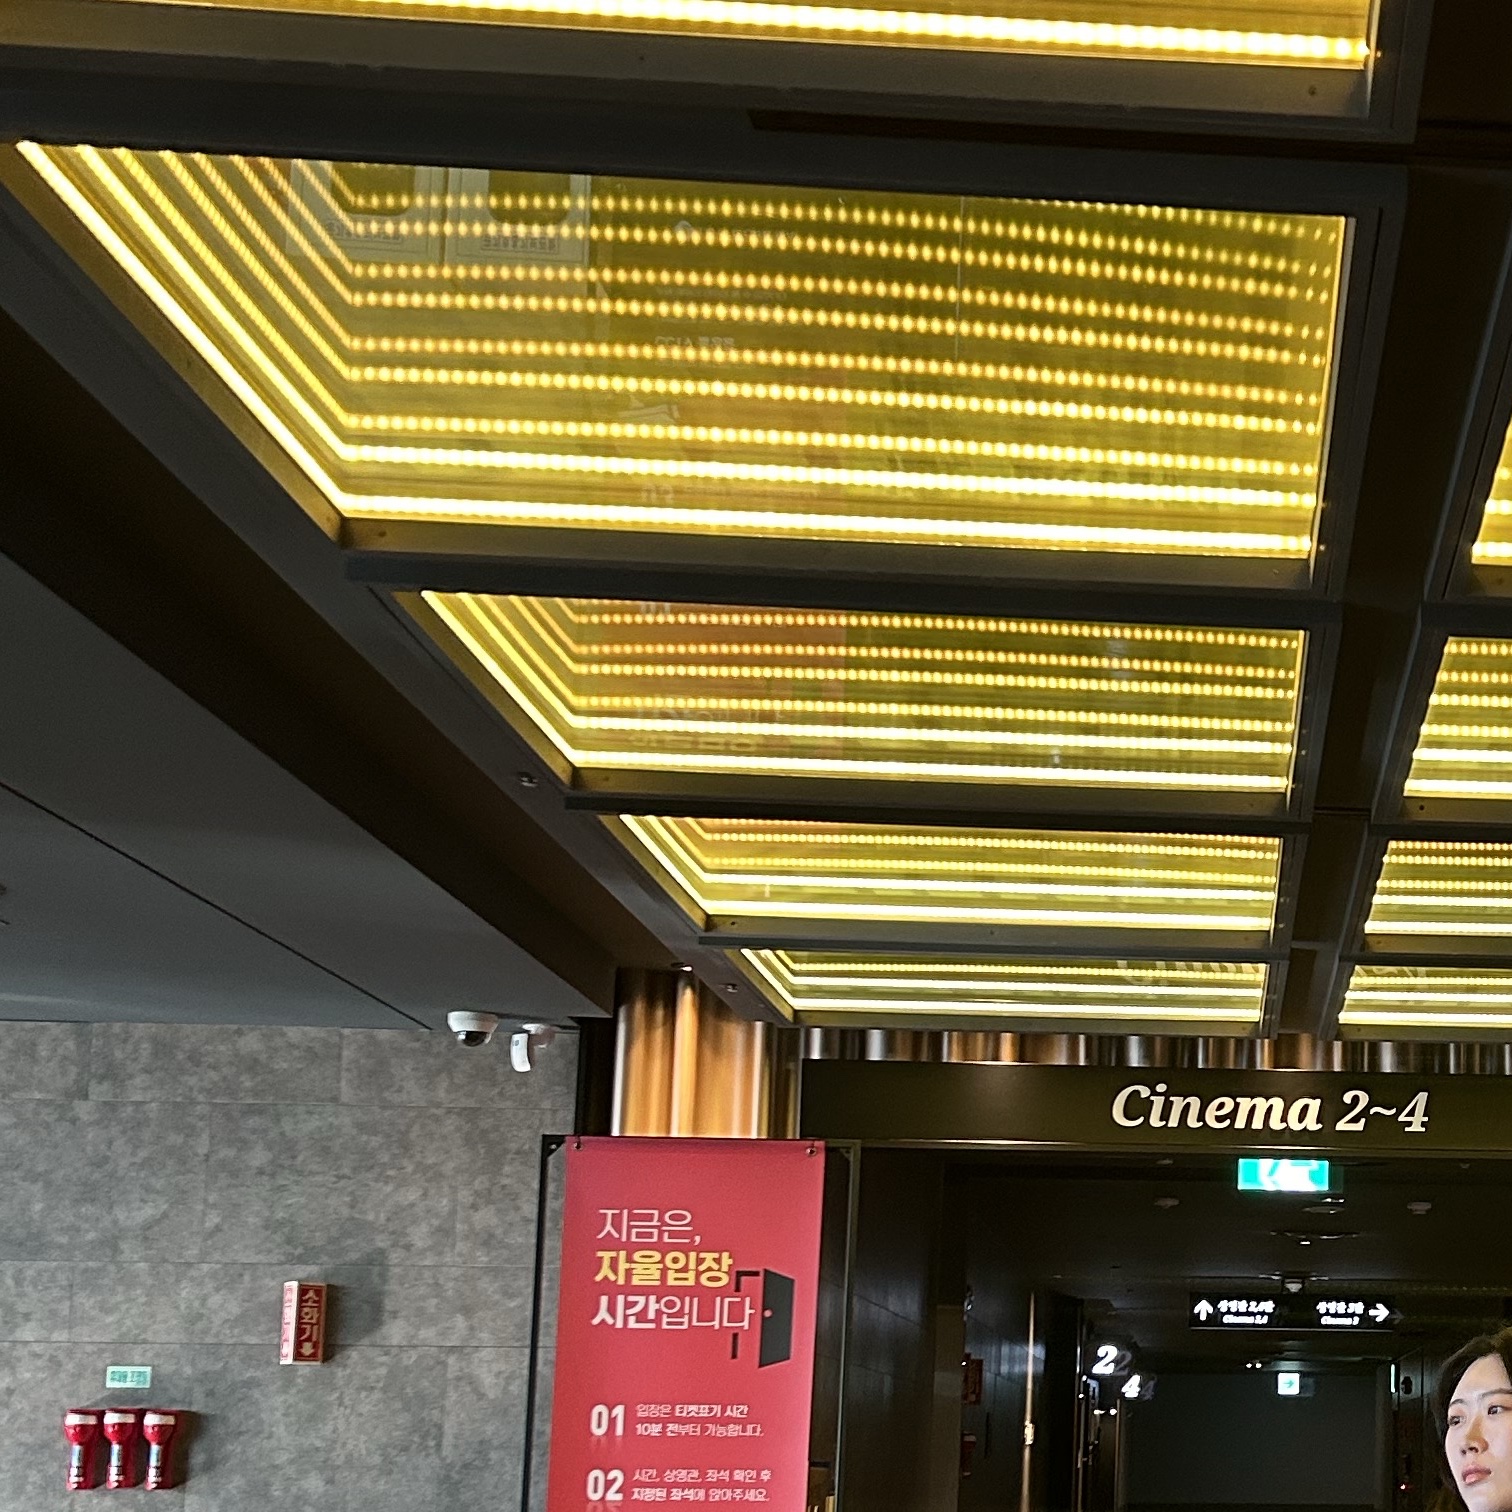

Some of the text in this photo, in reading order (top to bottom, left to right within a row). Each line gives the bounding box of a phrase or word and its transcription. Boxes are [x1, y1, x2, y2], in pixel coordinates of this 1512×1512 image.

[1111, 1083, 1429, 1132] Cinema 2~4
[596, 1208, 702, 1245] 지금은,
[594, 1250, 733, 1288] 자율입장
[300, 1289, 320, 1342] 소화기
[591, 1294, 756, 1330] 시간입니다
[1092, 1345, 1118, 1374] 2
[1121, 1374, 1141, 1398] 4
[590, 1404, 625, 1436] 01
[635, 1404, 672, 1418] 입장은
[724, 1404, 749, 1418] 시간
[635, 1423, 764, 1437] 10분 전부터 가능합니다.
[587, 1469, 624, 1501] 02
[705, 1469, 730, 1482] 좌석
[733, 1469, 757, 1483] 확인
[760, 1469, 772, 1483] 후
[631, 1488, 668, 1501] 지정된
[669, 1488, 706, 1501] 좌석에
